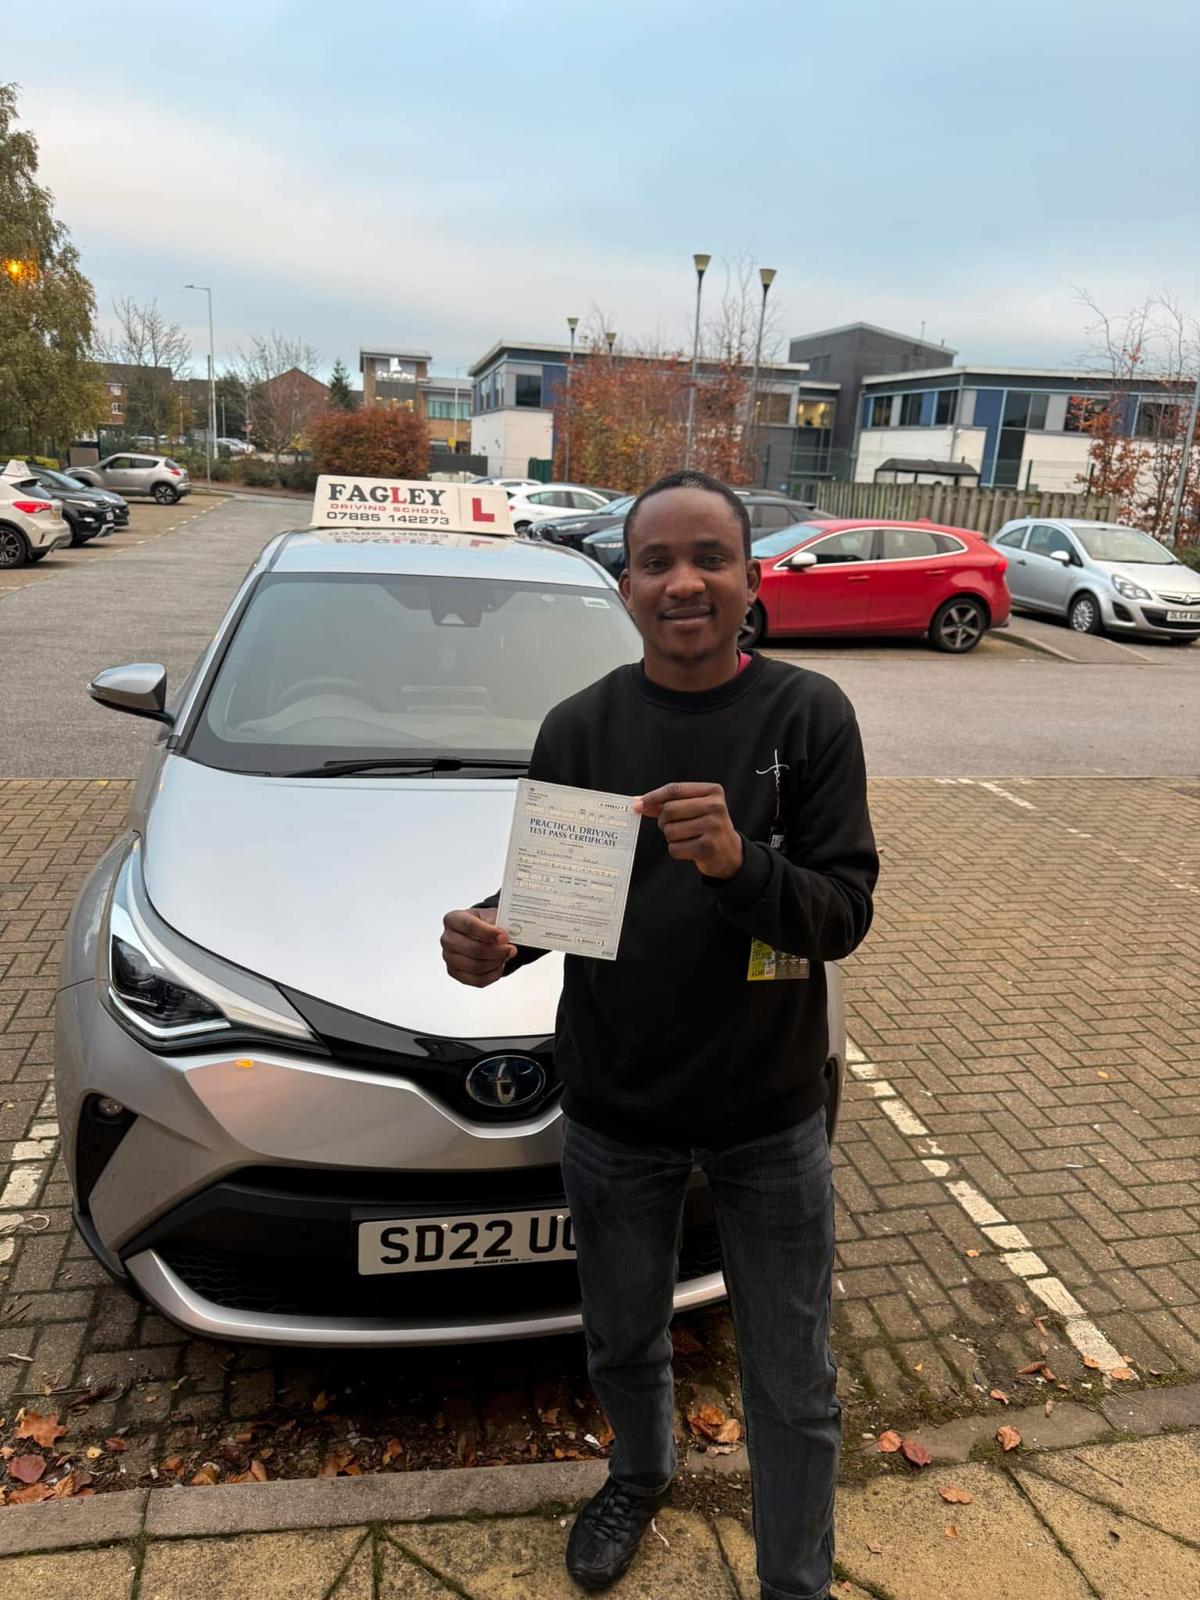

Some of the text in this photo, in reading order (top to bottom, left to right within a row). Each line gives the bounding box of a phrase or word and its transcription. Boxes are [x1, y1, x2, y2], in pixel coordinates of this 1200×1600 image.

[328, 483, 446, 506] FAGLEY
[327, 512, 449, 525] 07885 142273
[330, 503, 447, 515] DRIVING SCHOOL
[472, 498, 495, 522] L
[529, 826, 546, 836] TEST
[548, 829, 567, 840] PASS
[569, 833, 617, 848] CERTIFICATE
[530, 817, 618, 840] PRACTICAL DRIVING
[380, 1220, 513, 1264] SD22
